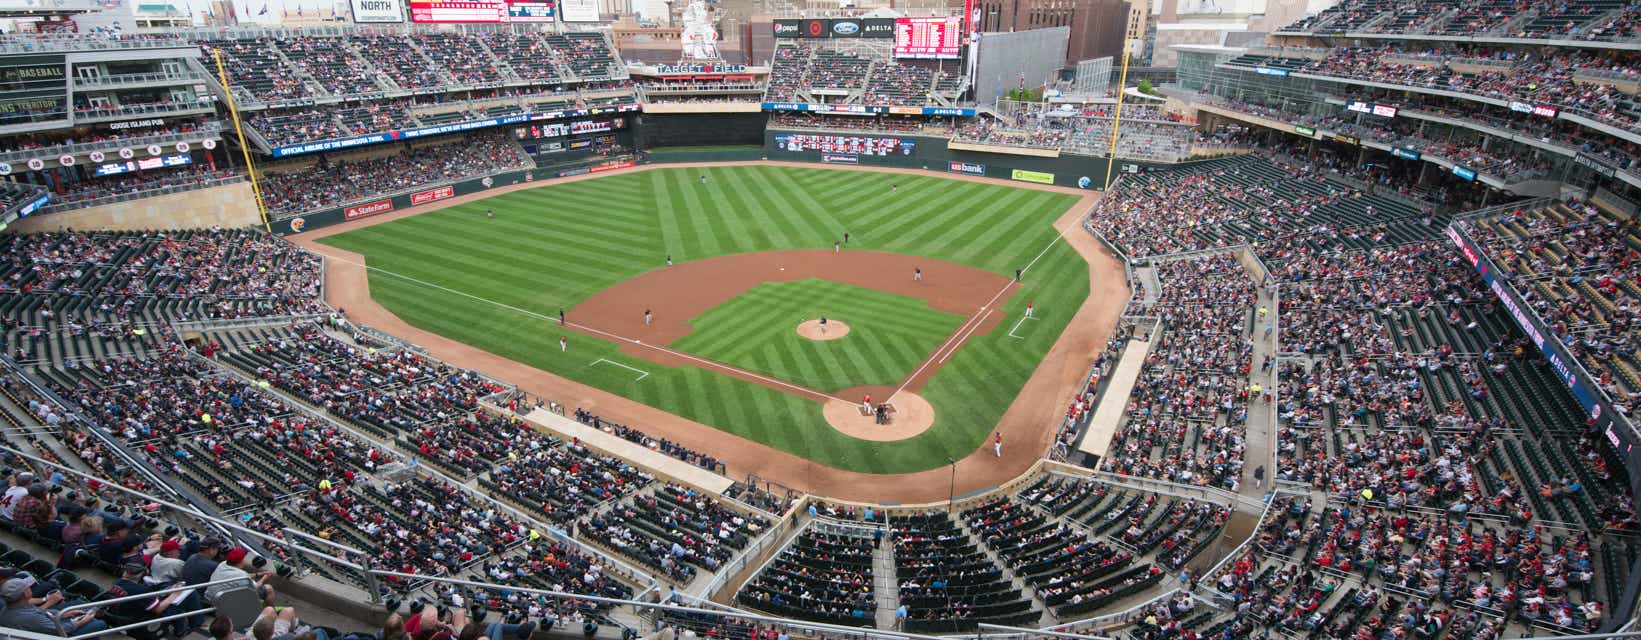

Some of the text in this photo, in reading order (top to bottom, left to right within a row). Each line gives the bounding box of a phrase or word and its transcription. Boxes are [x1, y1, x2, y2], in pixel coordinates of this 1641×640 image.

[361, 1, 391, 11] NORTH
[20, 67, 63, 78] BASEBALL
[656, 65, 703, 73] TARGET
[110, 122, 129, 130] GOOSE
[130, 120, 151, 128] ISLAND
[281, 146, 304, 155] OFFICIAL
[341, 137, 368, 147] MINNESOTA
